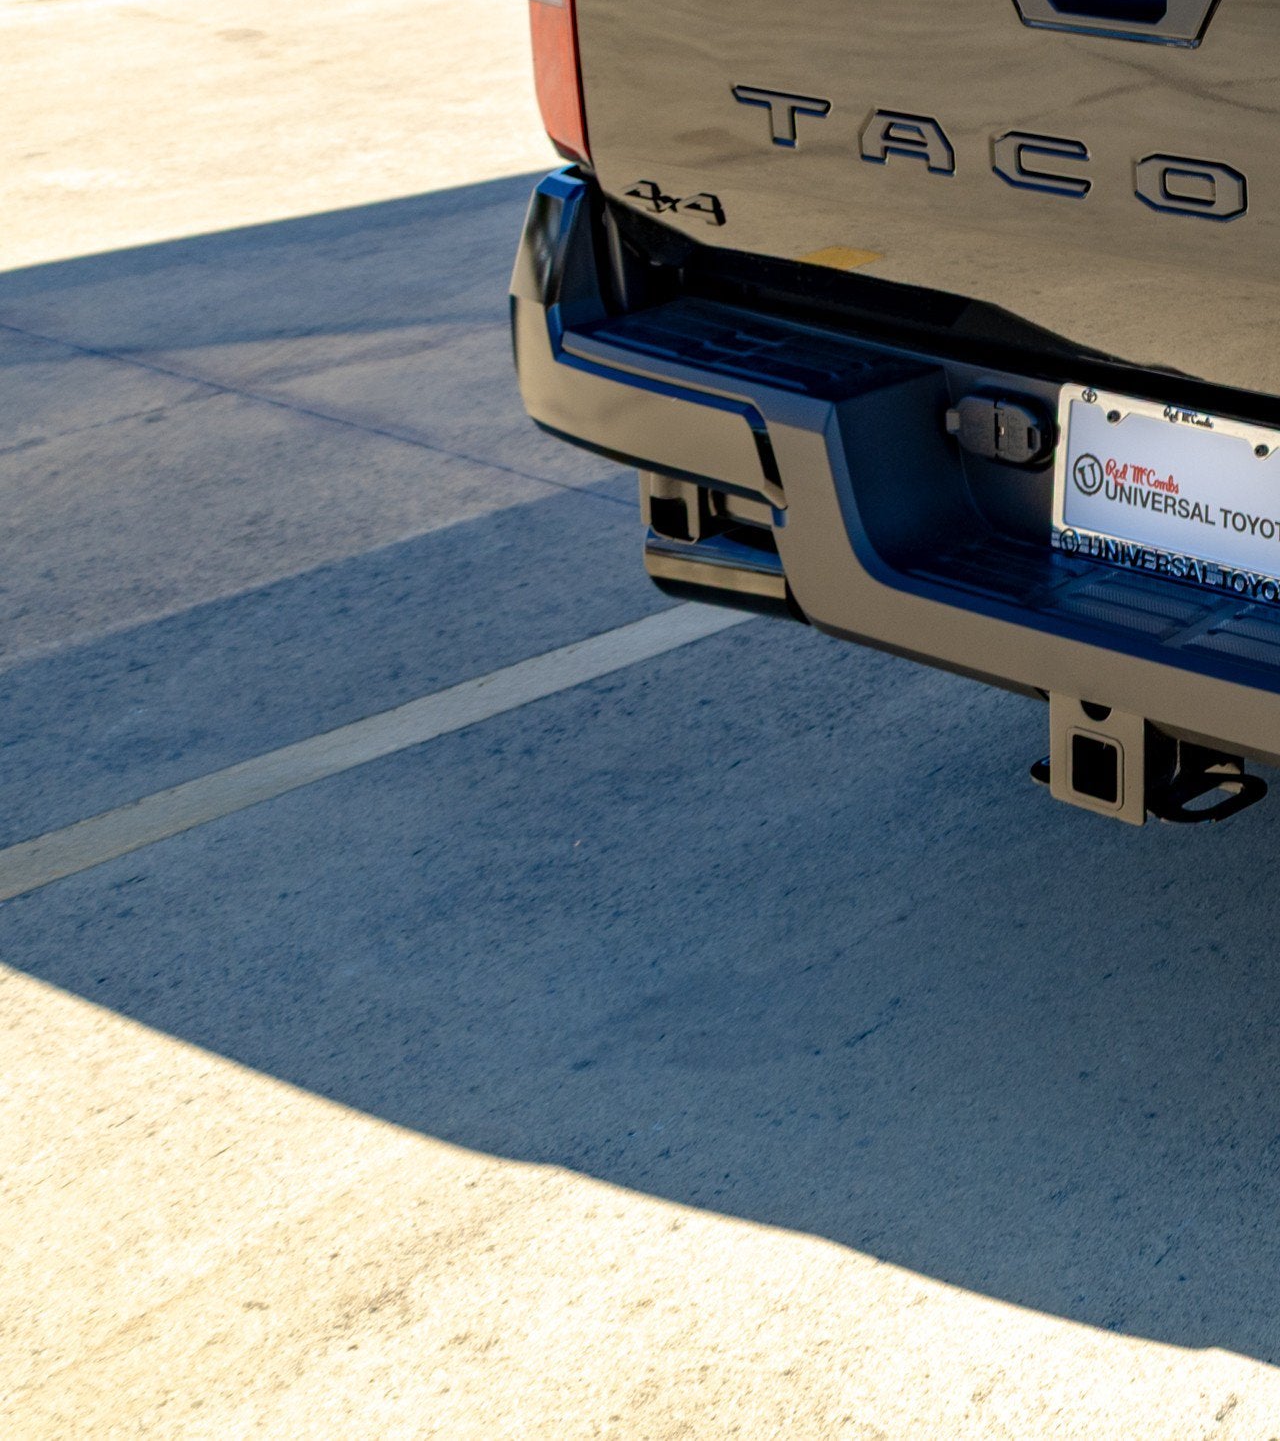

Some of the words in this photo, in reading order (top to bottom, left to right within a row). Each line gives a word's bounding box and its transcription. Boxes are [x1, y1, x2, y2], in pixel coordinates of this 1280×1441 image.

[1104, 458, 1128, 489] Red
[1130, 463, 1180, 495] McCombs
[1104, 481, 1217, 526] UNIVERSAL
[1087, 535, 1216, 585] UNIVERSAL
